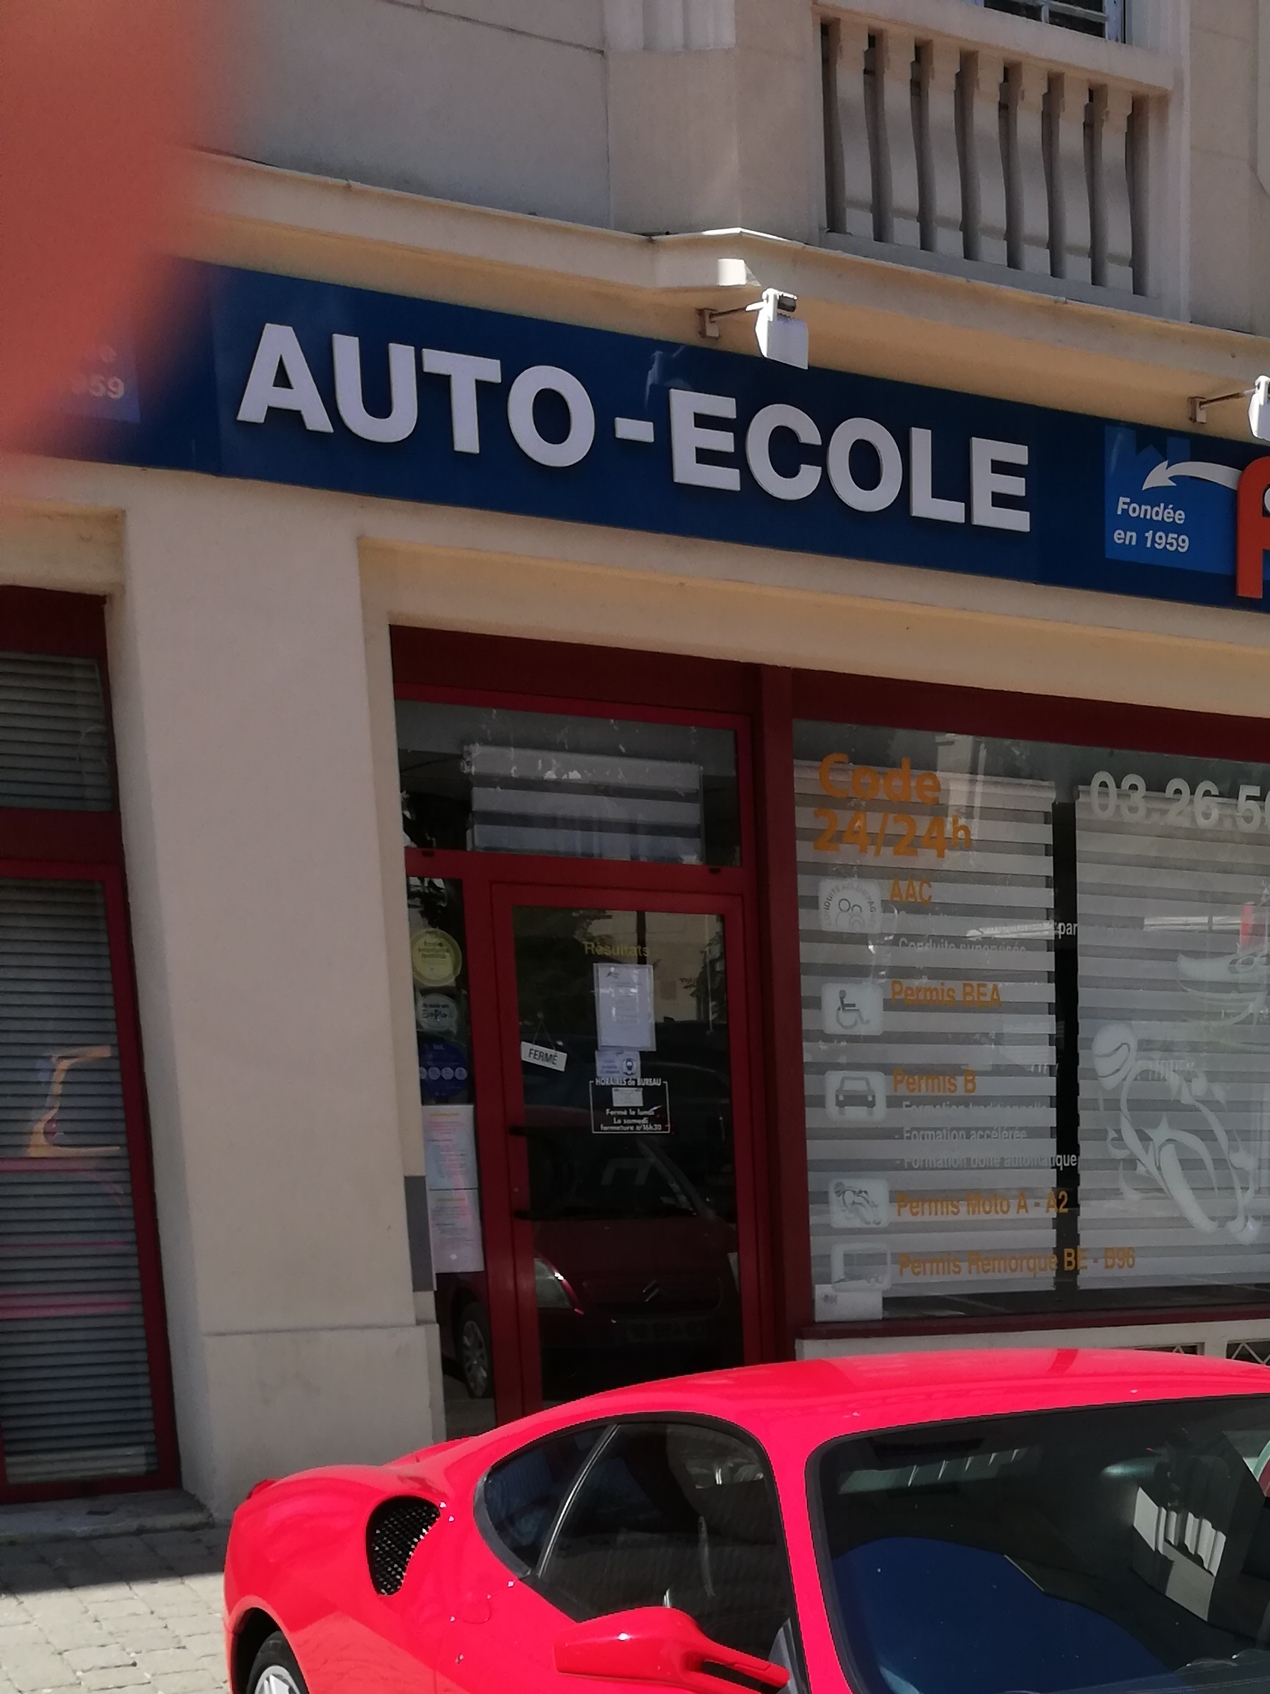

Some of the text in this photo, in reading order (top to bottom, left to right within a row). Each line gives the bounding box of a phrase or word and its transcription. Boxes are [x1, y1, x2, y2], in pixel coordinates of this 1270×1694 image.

[1116, 497, 1186, 525] Fondée
[1112, 528, 1190, 554] en 1959
[818, 752, 942, 805] Code
[890, 877, 933, 905] AAC
[891, 979, 1002, 1009] Permis BEA
[527, 1047, 559, 1066] FERMÉ
[892, 1068, 977, 1094] Permis B
[896, 1193, 960, 1217] Permis
[966, 1192, 1010, 1216] Moto
[1016, 1191, 1029, 1214] A
[1045, 1190, 1069, 1214] A2
[898, 1252, 962, 1277] Permis
[968, 1250, 1058, 1278] Remorque
[1063, 1247, 1089, 1272] BE
[1104, 1246, 1136, 1270] B96
